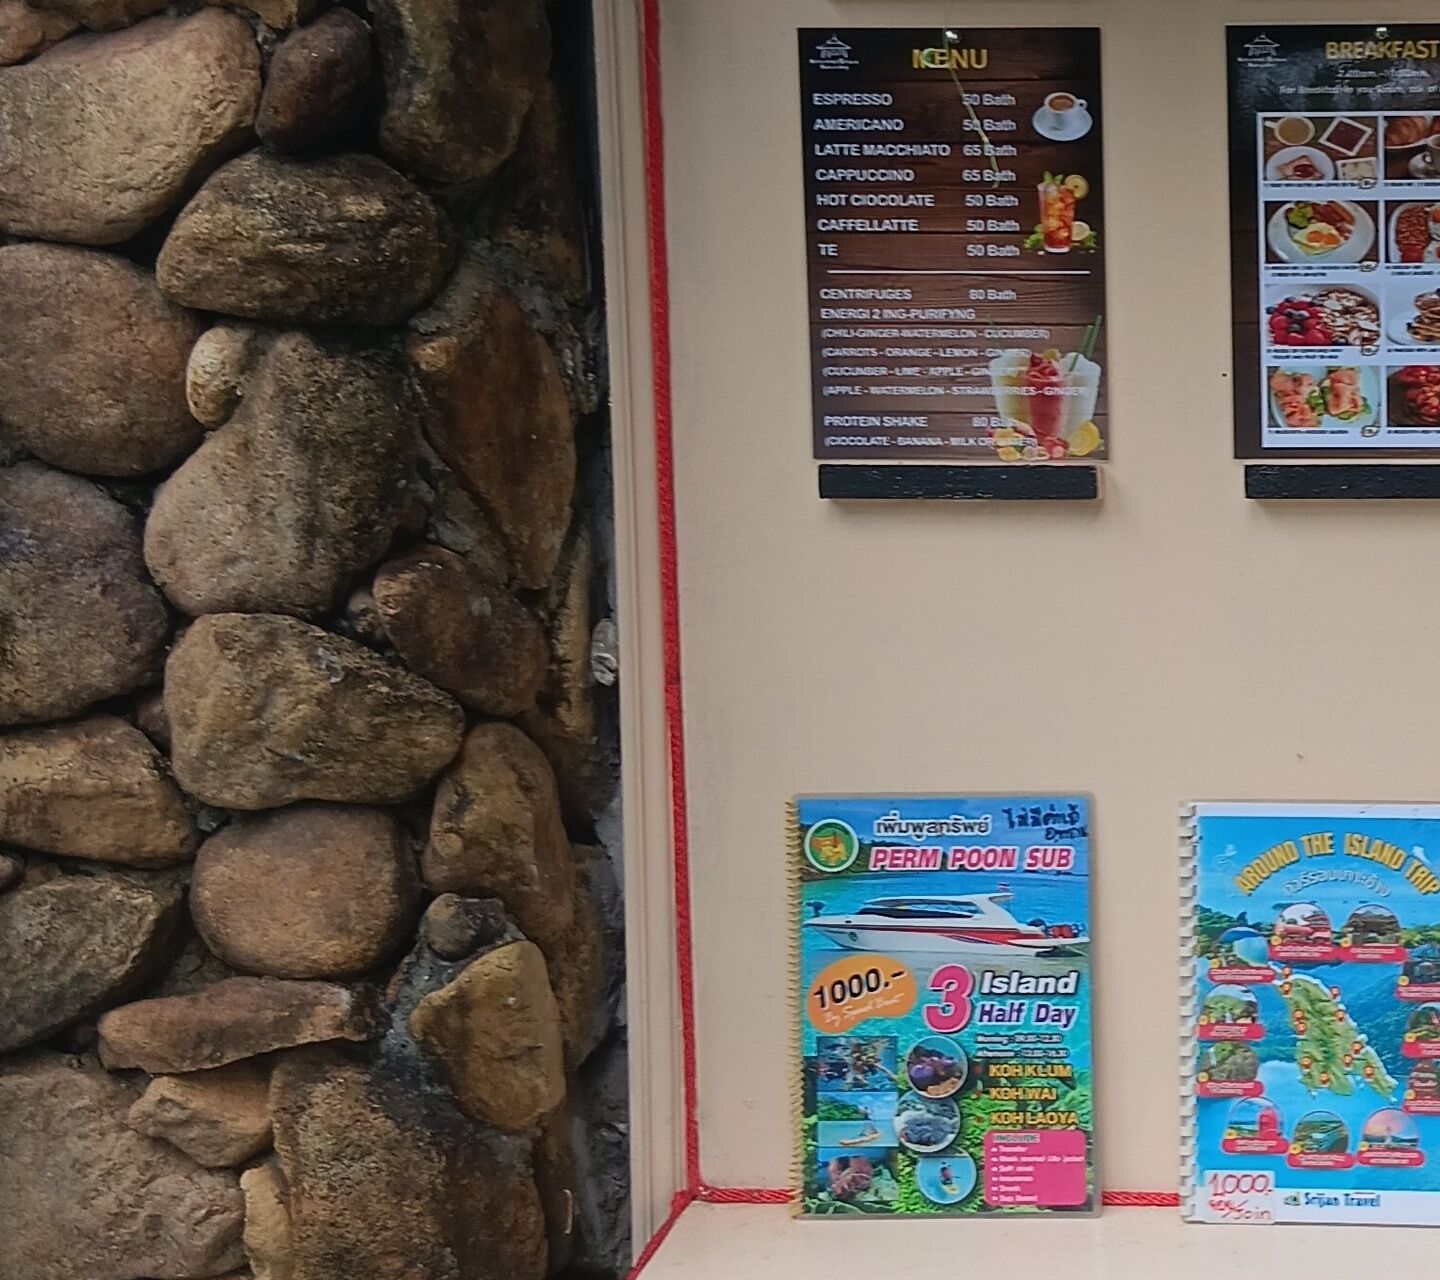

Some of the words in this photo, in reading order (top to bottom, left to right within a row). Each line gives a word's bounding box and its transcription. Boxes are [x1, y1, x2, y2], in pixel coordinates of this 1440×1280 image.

[1325, 40, 1440, 60] BREAKFAST
[813, 93, 893, 106] ESPRESSO
[813, 118, 904, 131] AMERICANO
[814, 144, 861, 156] LATTE
[862, 144, 951, 157] MACCHIATO
[963, 144, 982, 156] 65
[815, 169, 915, 181] CAPPUCCINO
[962, 169, 981, 181] 65
[816, 194, 848, 206] HOT
[965, 194, 983, 206] 50
[817, 219, 919, 231] CAFFELLATTE
[966, 219, 985, 231] 50
[817, 244, 838, 256] TE
[966, 244, 985, 256] 50
[820, 288, 912, 300] CENTRIFUGES
[824, 416, 881, 427] PROTEIN
[882, 416, 928, 427] SHAKE
[871, 847, 942, 870] PERM
[949, 847, 1018, 870] POON
[1025, 847, 1074, 870] SUB
[1233, 840, 1299, 896] AROUND
[1301, 832, 1335, 858] THE
[1344, 832, 1408, 870] ISLAND
[924, 963, 974, 1034] 3
[979, 970, 1080, 995] Island
[977, 1000, 1026, 1023] Half
[1033, 1001, 1078, 1030] Day
[989, 1064, 1024, 1078] KOH
[989, 1087, 1024, 1101] KOH
[990, 1111, 1024, 1125] KOH
